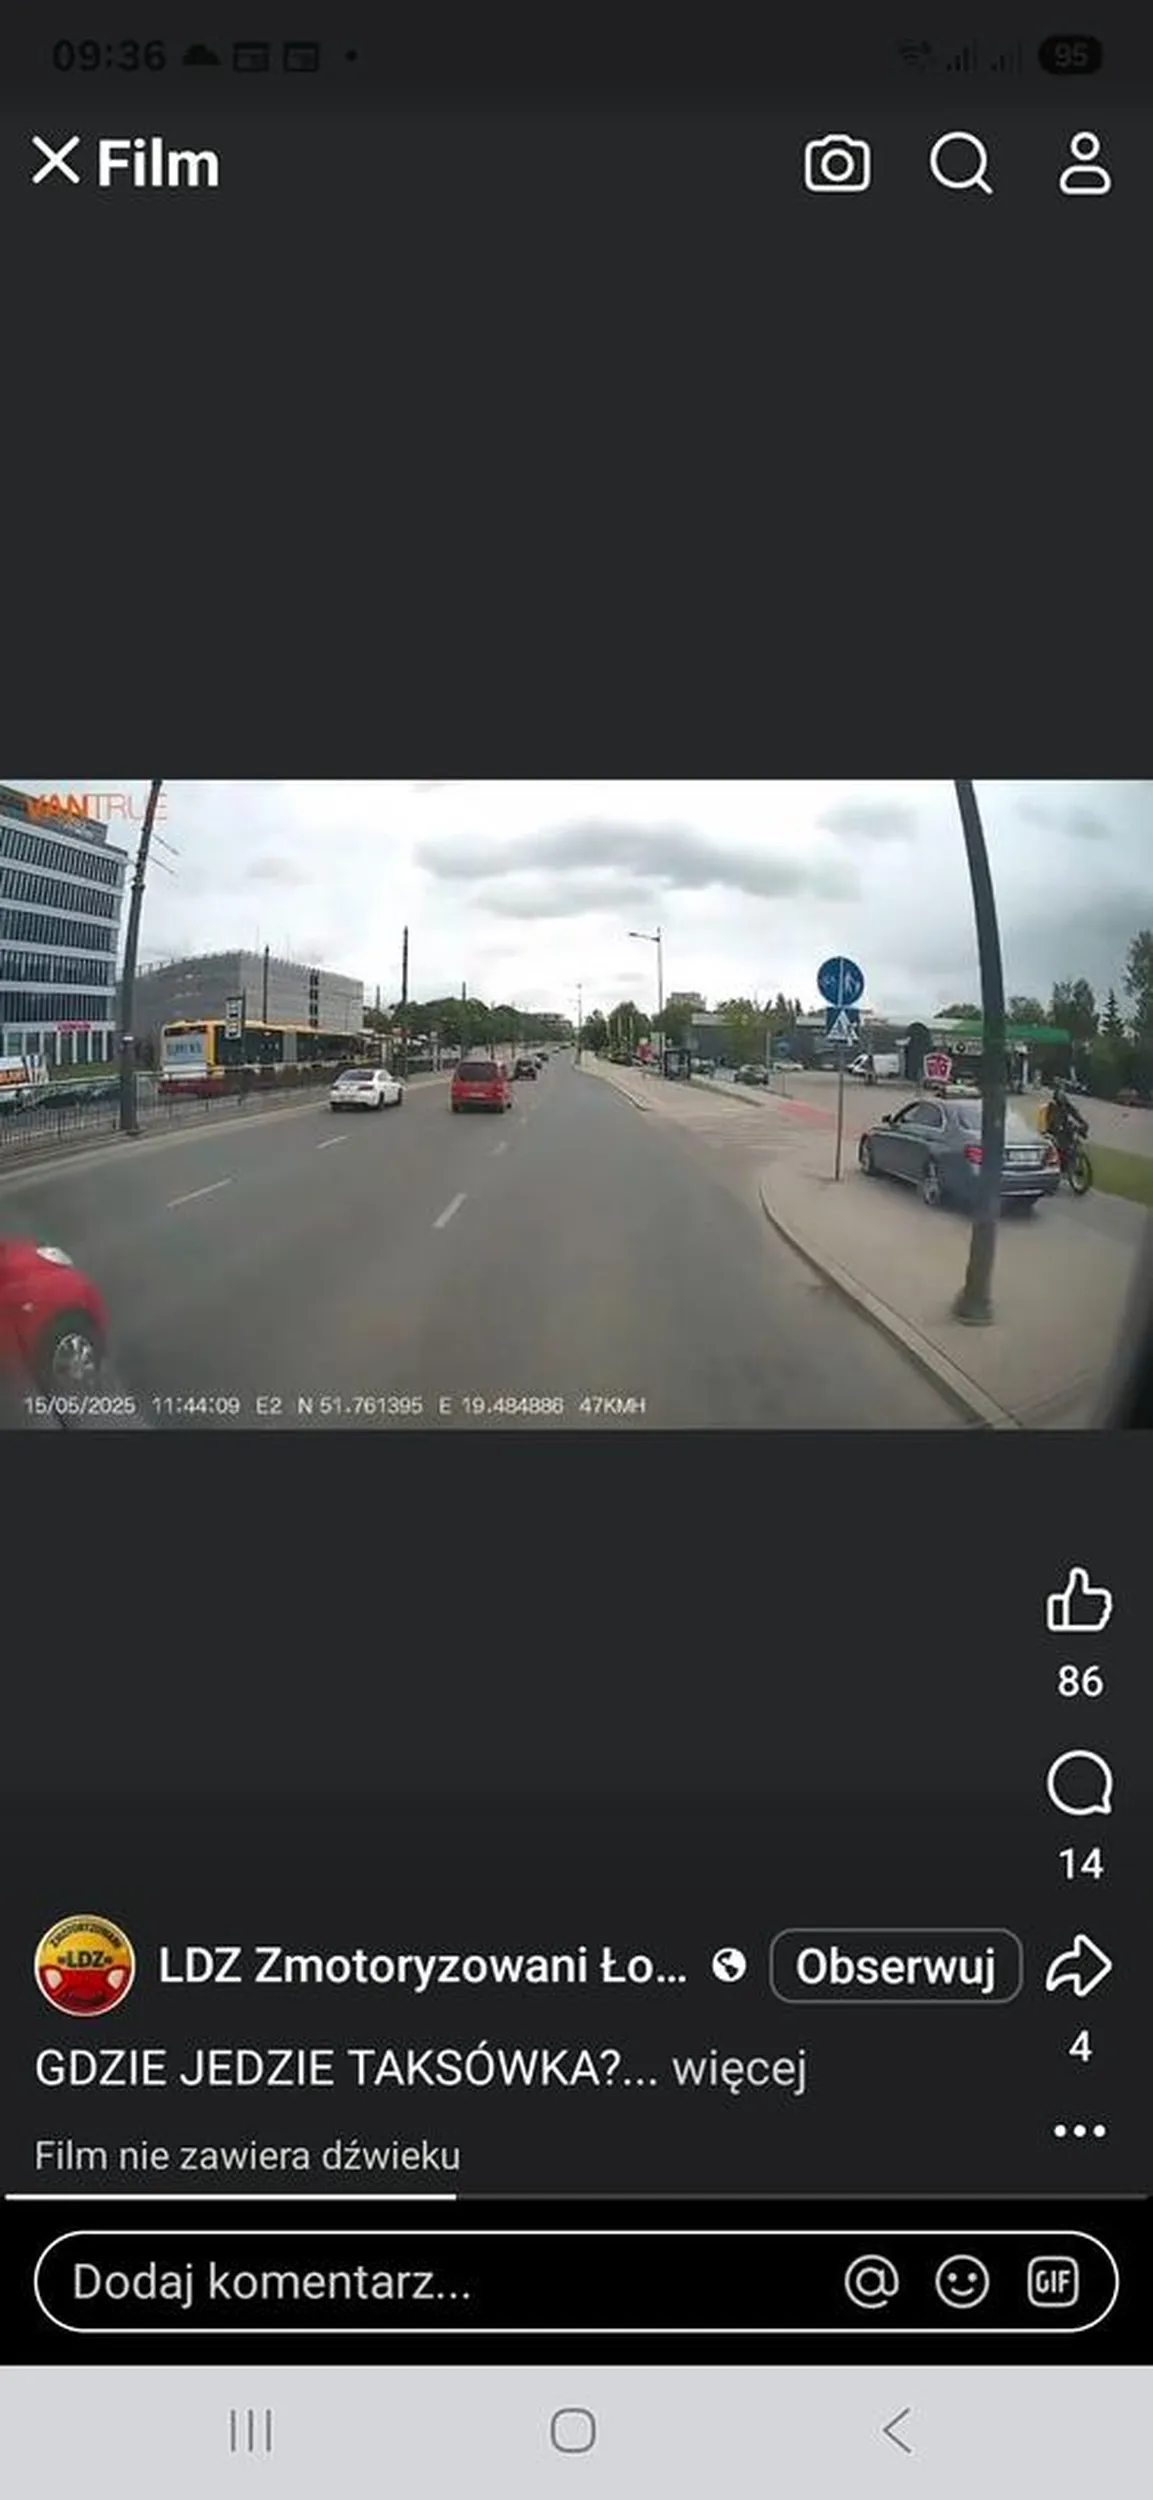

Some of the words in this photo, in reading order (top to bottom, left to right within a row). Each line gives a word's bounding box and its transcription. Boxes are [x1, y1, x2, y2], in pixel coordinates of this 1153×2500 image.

[53, 39, 167, 73] 09:36
[1055, 41, 1088, 68] 95
[99, 137, 219, 187] Film
[1058, 1664, 1104, 1697] 86
[1059, 1847, 1104, 1879] 14
[66, 1951, 105, 1968] LDZ
[160, 1946, 242, 1983] LDZ
[255, 1945, 587, 1993] Zmotoryzowani
[797, 1946, 994, 1991] Obserwuj
[1068, 2030, 1093, 2062] 4
[36, 2048, 167, 2086] GDZIE
[179, 2049, 334, 2086] JEDZIE
[347, 2039, 657, 2086] TAKSÓWKA?...
[672, 2049, 805, 2096] więcej
[36, 2139, 107, 2170] Film
[120, 2140, 170, 2170] nie
[180, 2140, 310, 2170] zawiera
[322, 2139, 460, 2170] dźwieku
[74, 2261, 193, 2310] Dodaj
[209, 2261, 470, 2301] komentarz...
[1035, 2269, 1071, 2294] GIF
